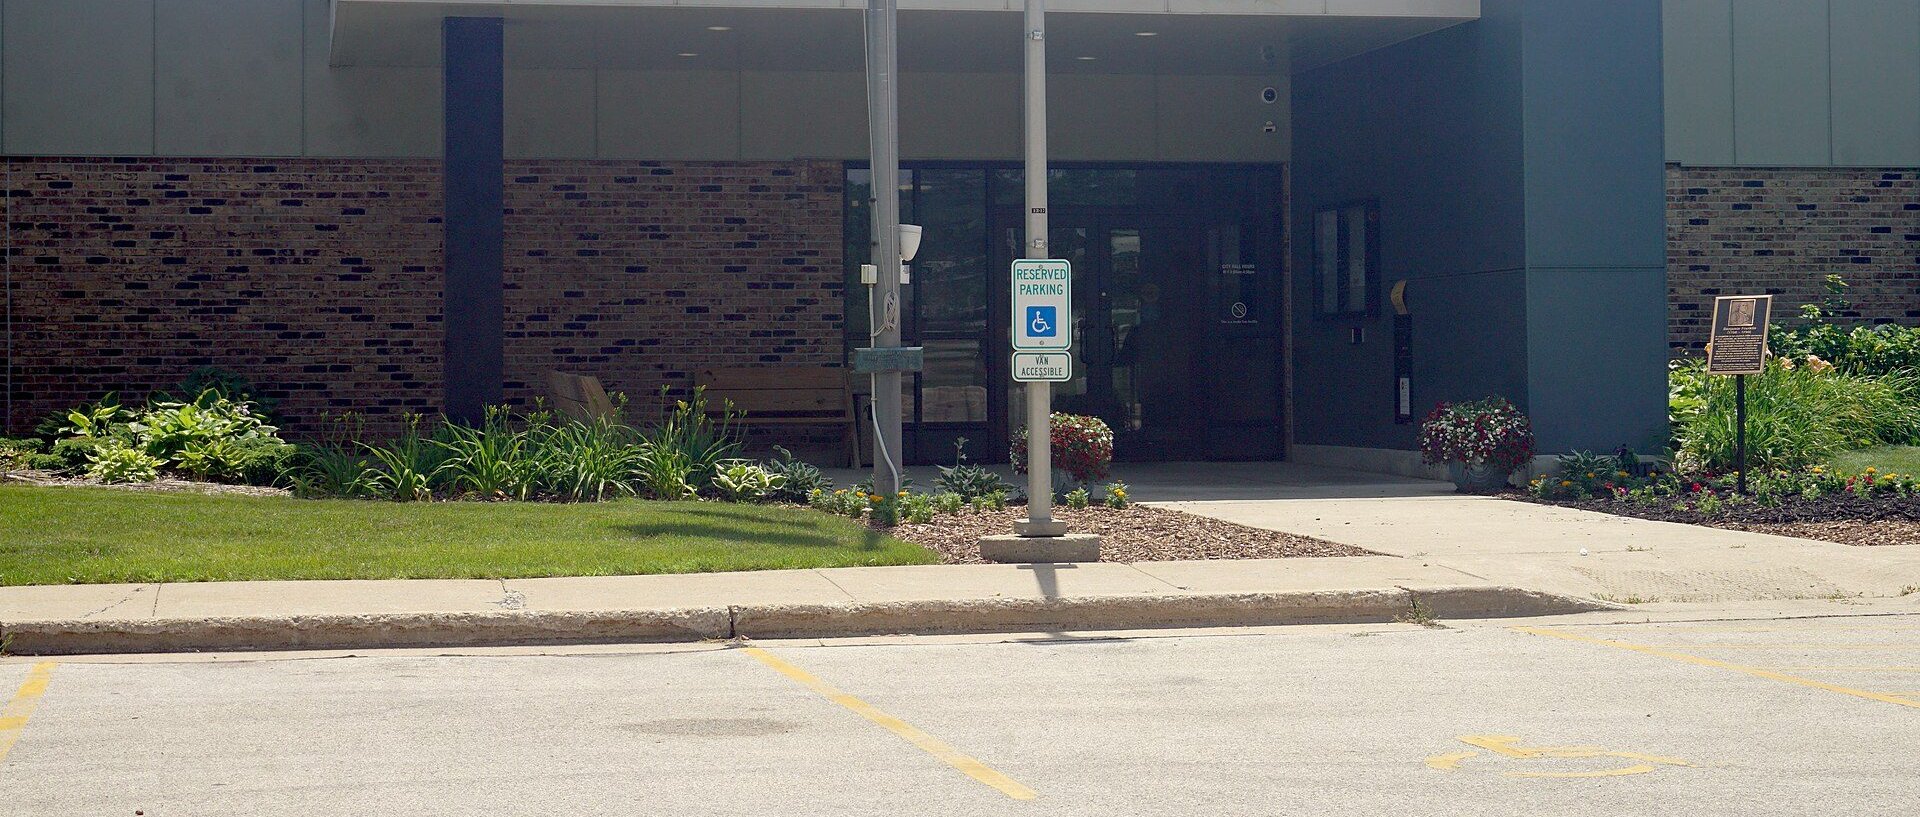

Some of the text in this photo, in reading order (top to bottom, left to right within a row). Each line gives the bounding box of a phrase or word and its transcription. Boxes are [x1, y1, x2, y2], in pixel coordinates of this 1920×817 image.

[1016, 269, 1066, 280] RESERVED
[1019, 284, 1063, 295] PARKING
[1035, 357, 1049, 365] VAN
[1021, 367, 1063, 376] ACCESSIBLE
